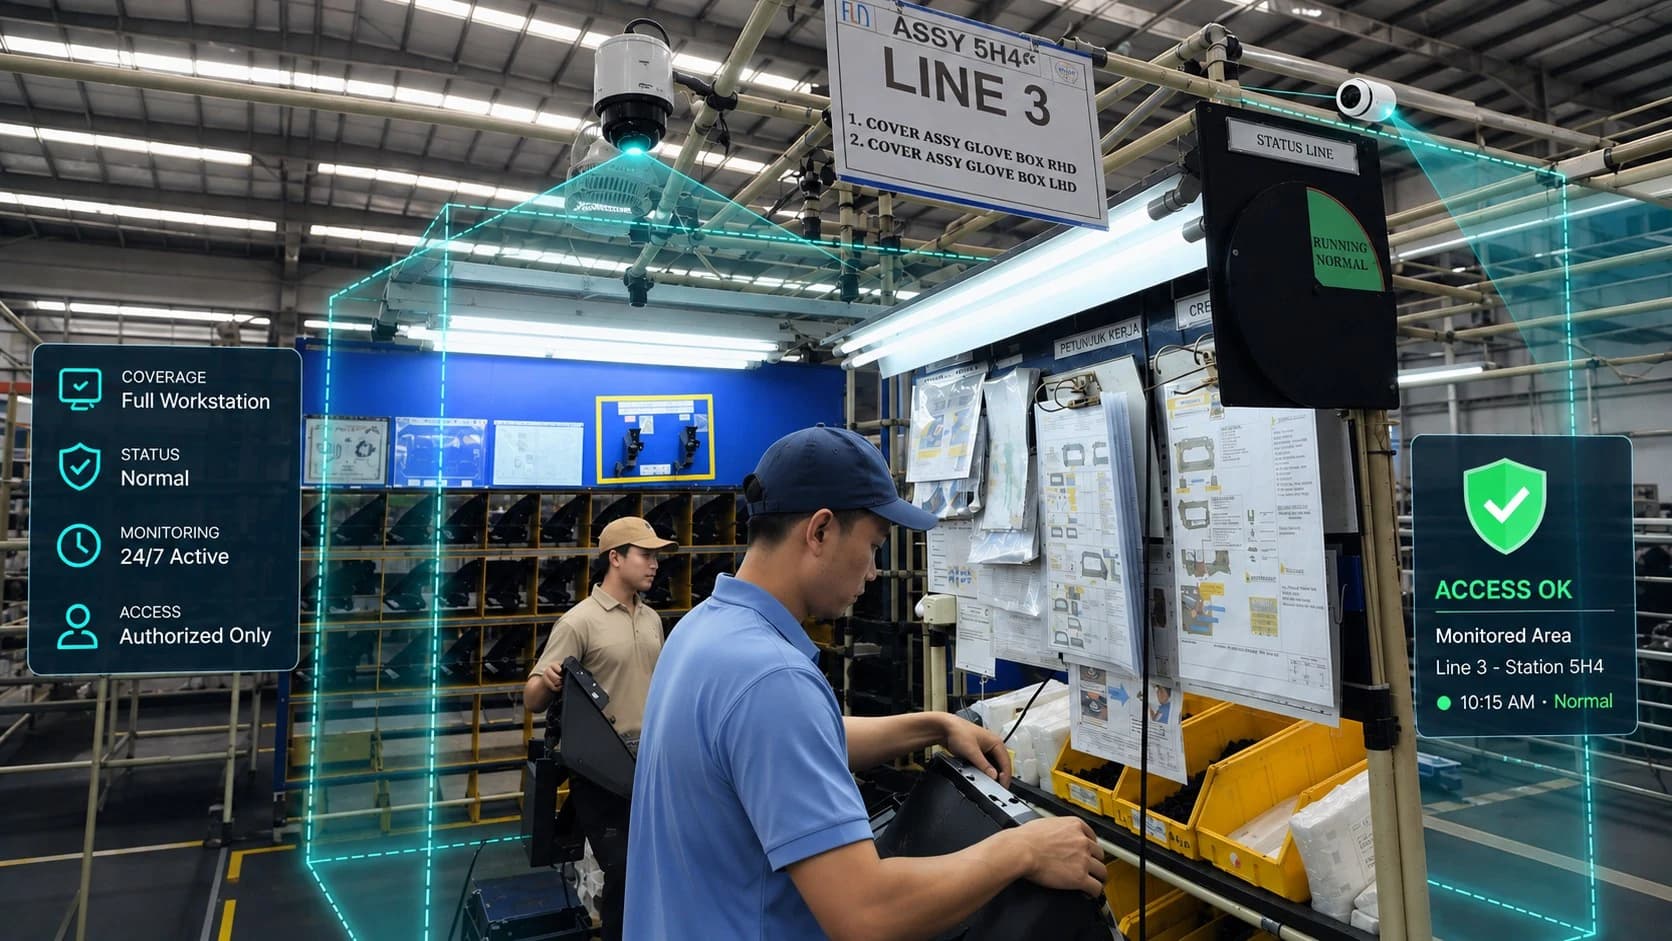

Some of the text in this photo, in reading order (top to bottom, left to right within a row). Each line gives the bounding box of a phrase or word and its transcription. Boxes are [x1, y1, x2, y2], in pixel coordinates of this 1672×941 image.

[893, 15, 966, 53] ASSY
[883, 46, 1051, 127] LINE 3
[848, 112, 1077, 175] 1. COVER ASSY GLOVE BOX RHD
[1257, 134, 1334, 160] STATUS LINE
[850, 133, 1077, 193] 2. COVER ASSY GLOVE BOX LHD
[1313, 236, 1368, 254] RUNNING
[1316, 254, 1368, 271] NORMAL
[1060, 324, 1140, 354] PETUNJUK KERJA
